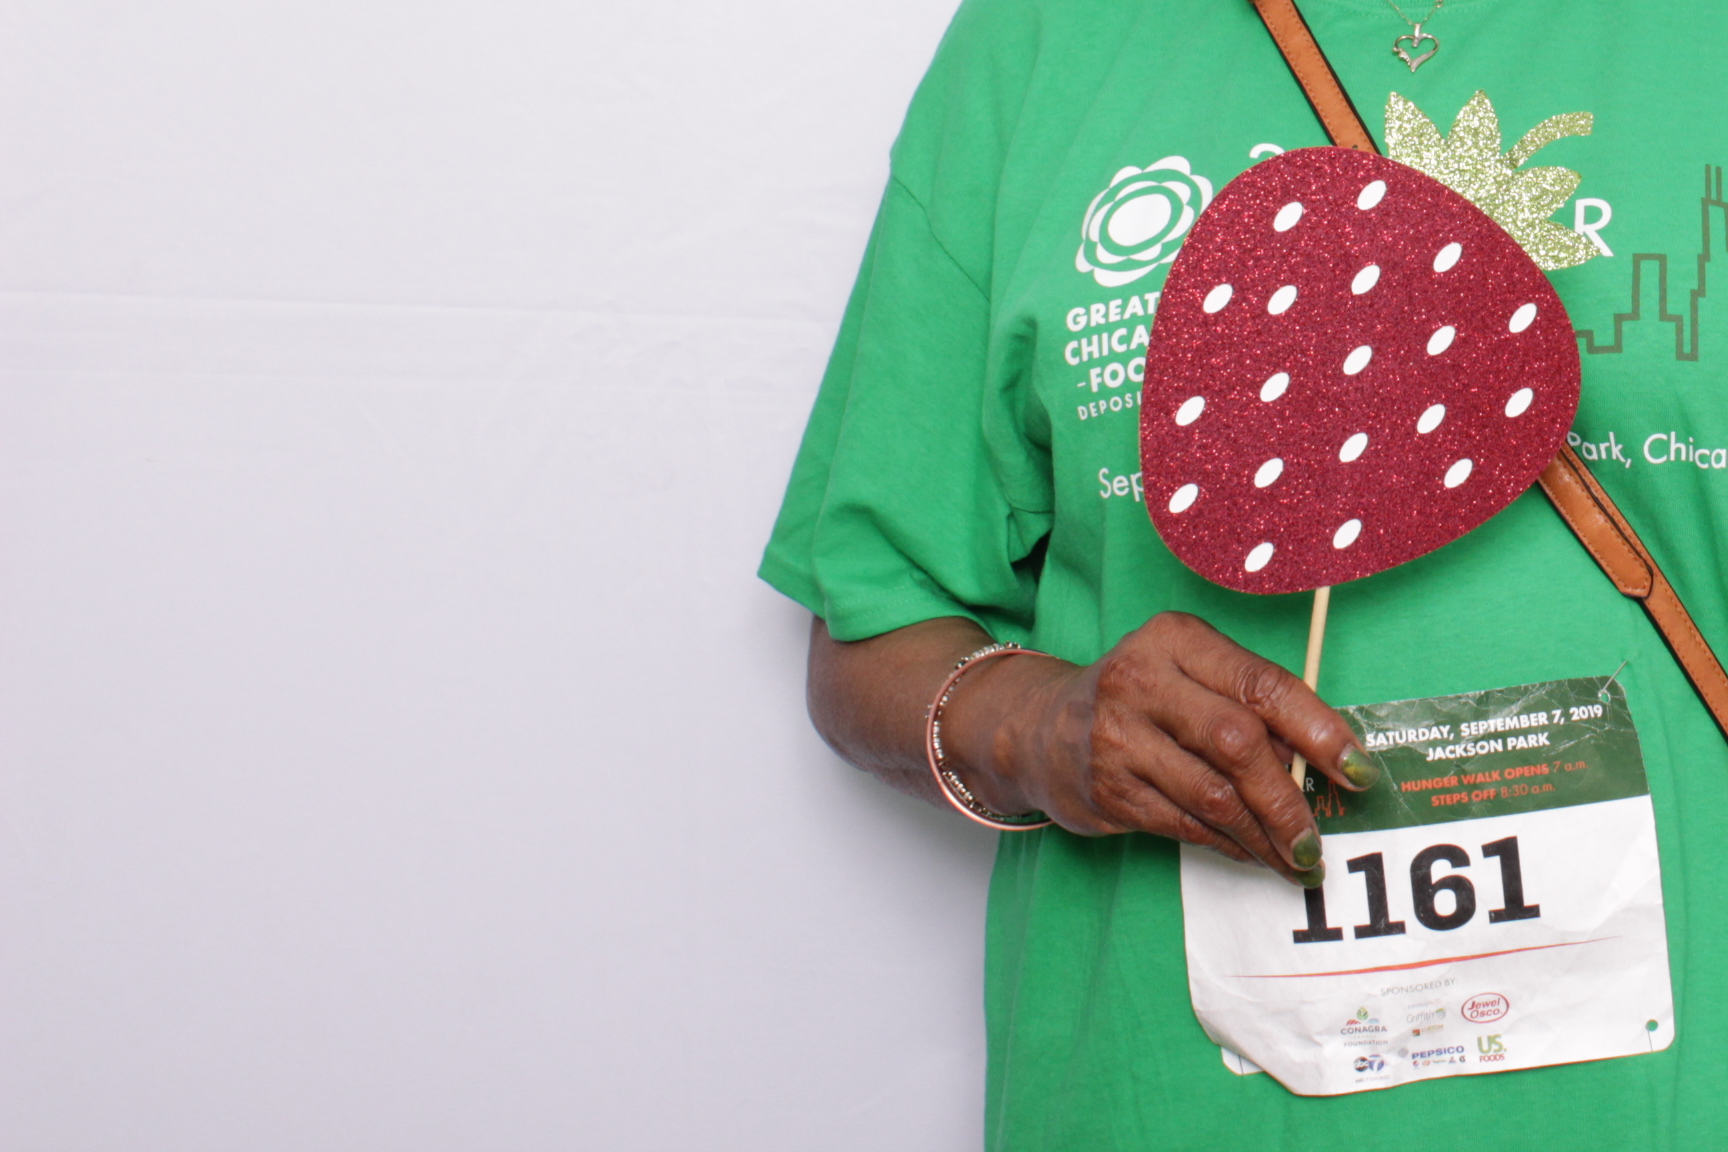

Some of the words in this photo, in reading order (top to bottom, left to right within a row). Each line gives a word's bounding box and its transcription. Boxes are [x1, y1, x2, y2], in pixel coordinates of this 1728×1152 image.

[1365, 724, 1454, 748] SATURDAY,
[1460, 710, 1549, 738] SEPTEMBER
[1551, 708, 1565, 725] 7,
[1569, 704, 1604, 722] 2019
[1426, 738, 1503, 762] JACKSON
[1507, 732, 1550, 751] PARK
[1401, 775, 1459, 792] HUNGER
[1461, 769, 1502, 785] WALK
[1504, 763, 1550, 780] OPENS
[1552, 760, 1562, 774] 7
[1564, 760, 1589, 773] a.m.
[1431, 792, 1469, 808] STEPS
[1471, 788, 1497, 803] OFF
[1501, 783, 1529, 798] 8:30
[1531, 782, 1556, 795] a.m.
[1292, 835, 1541, 944] 1161
[1380, 979, 1442, 997] SPONSORED
[1467, 997, 1501, 1011] Jewel
[1340, 1025, 1388, 1036] CONAGRA
[1343, 1039, 1389, 1048] FOUNDATION
[1411, 1045, 1465, 1060] PEPSICO
[1479, 1053, 1506, 1063] FOODS
